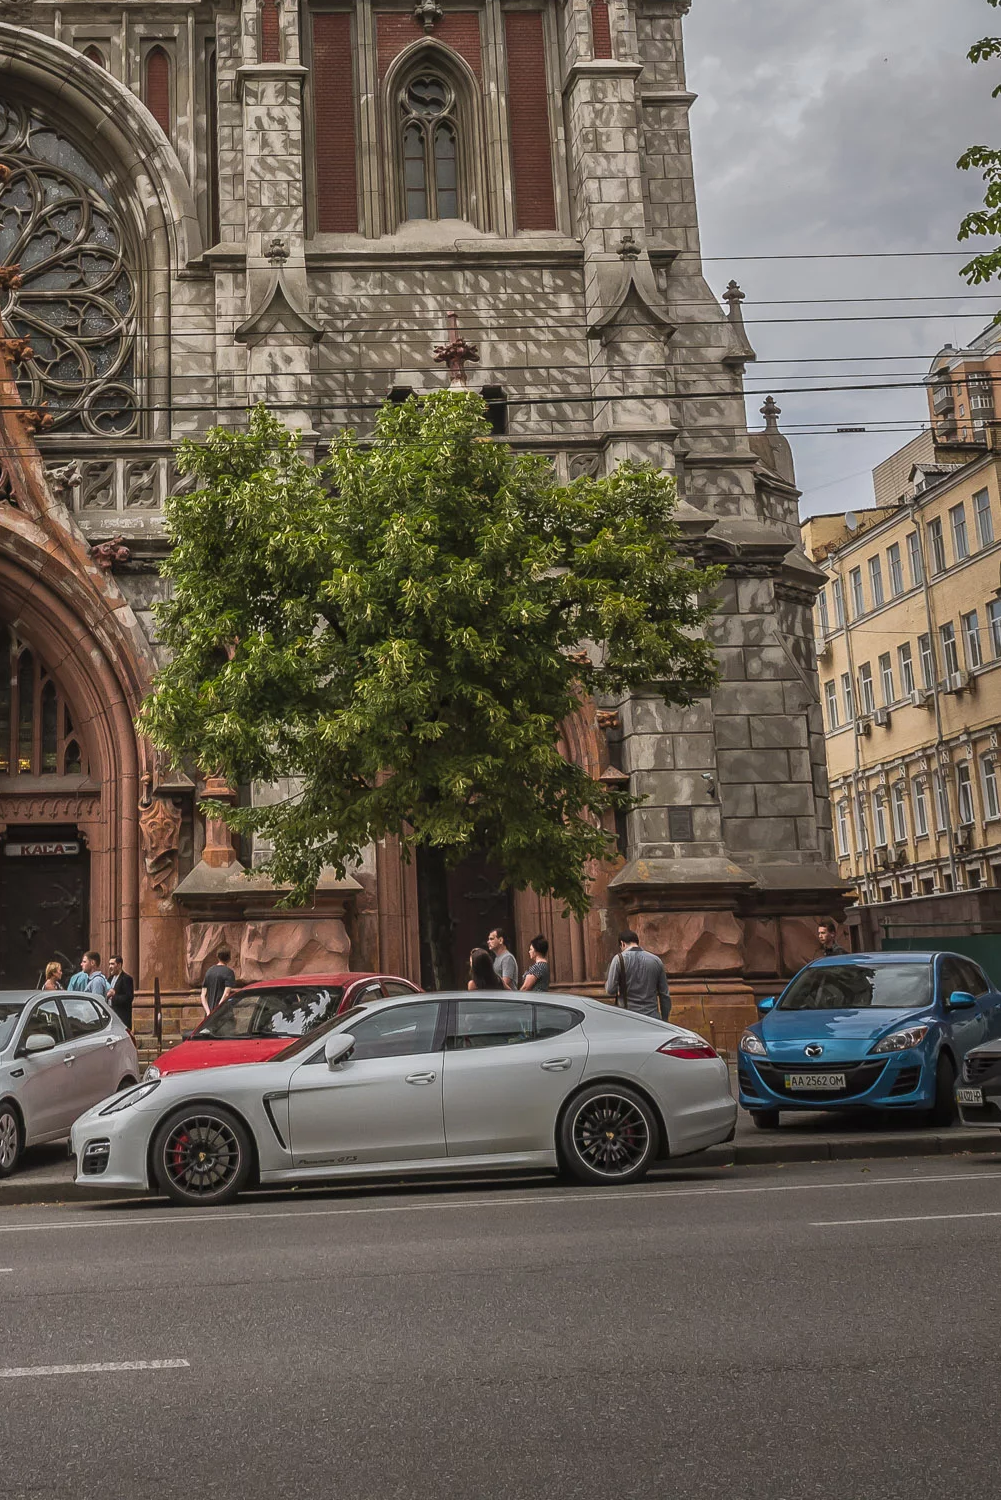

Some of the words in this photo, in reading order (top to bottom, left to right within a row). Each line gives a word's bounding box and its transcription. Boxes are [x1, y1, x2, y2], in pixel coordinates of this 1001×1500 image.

[791, 1076, 804, 1086] AA
[806, 1076, 827, 1086] 2562
[829, 1075, 844, 1085] OM
